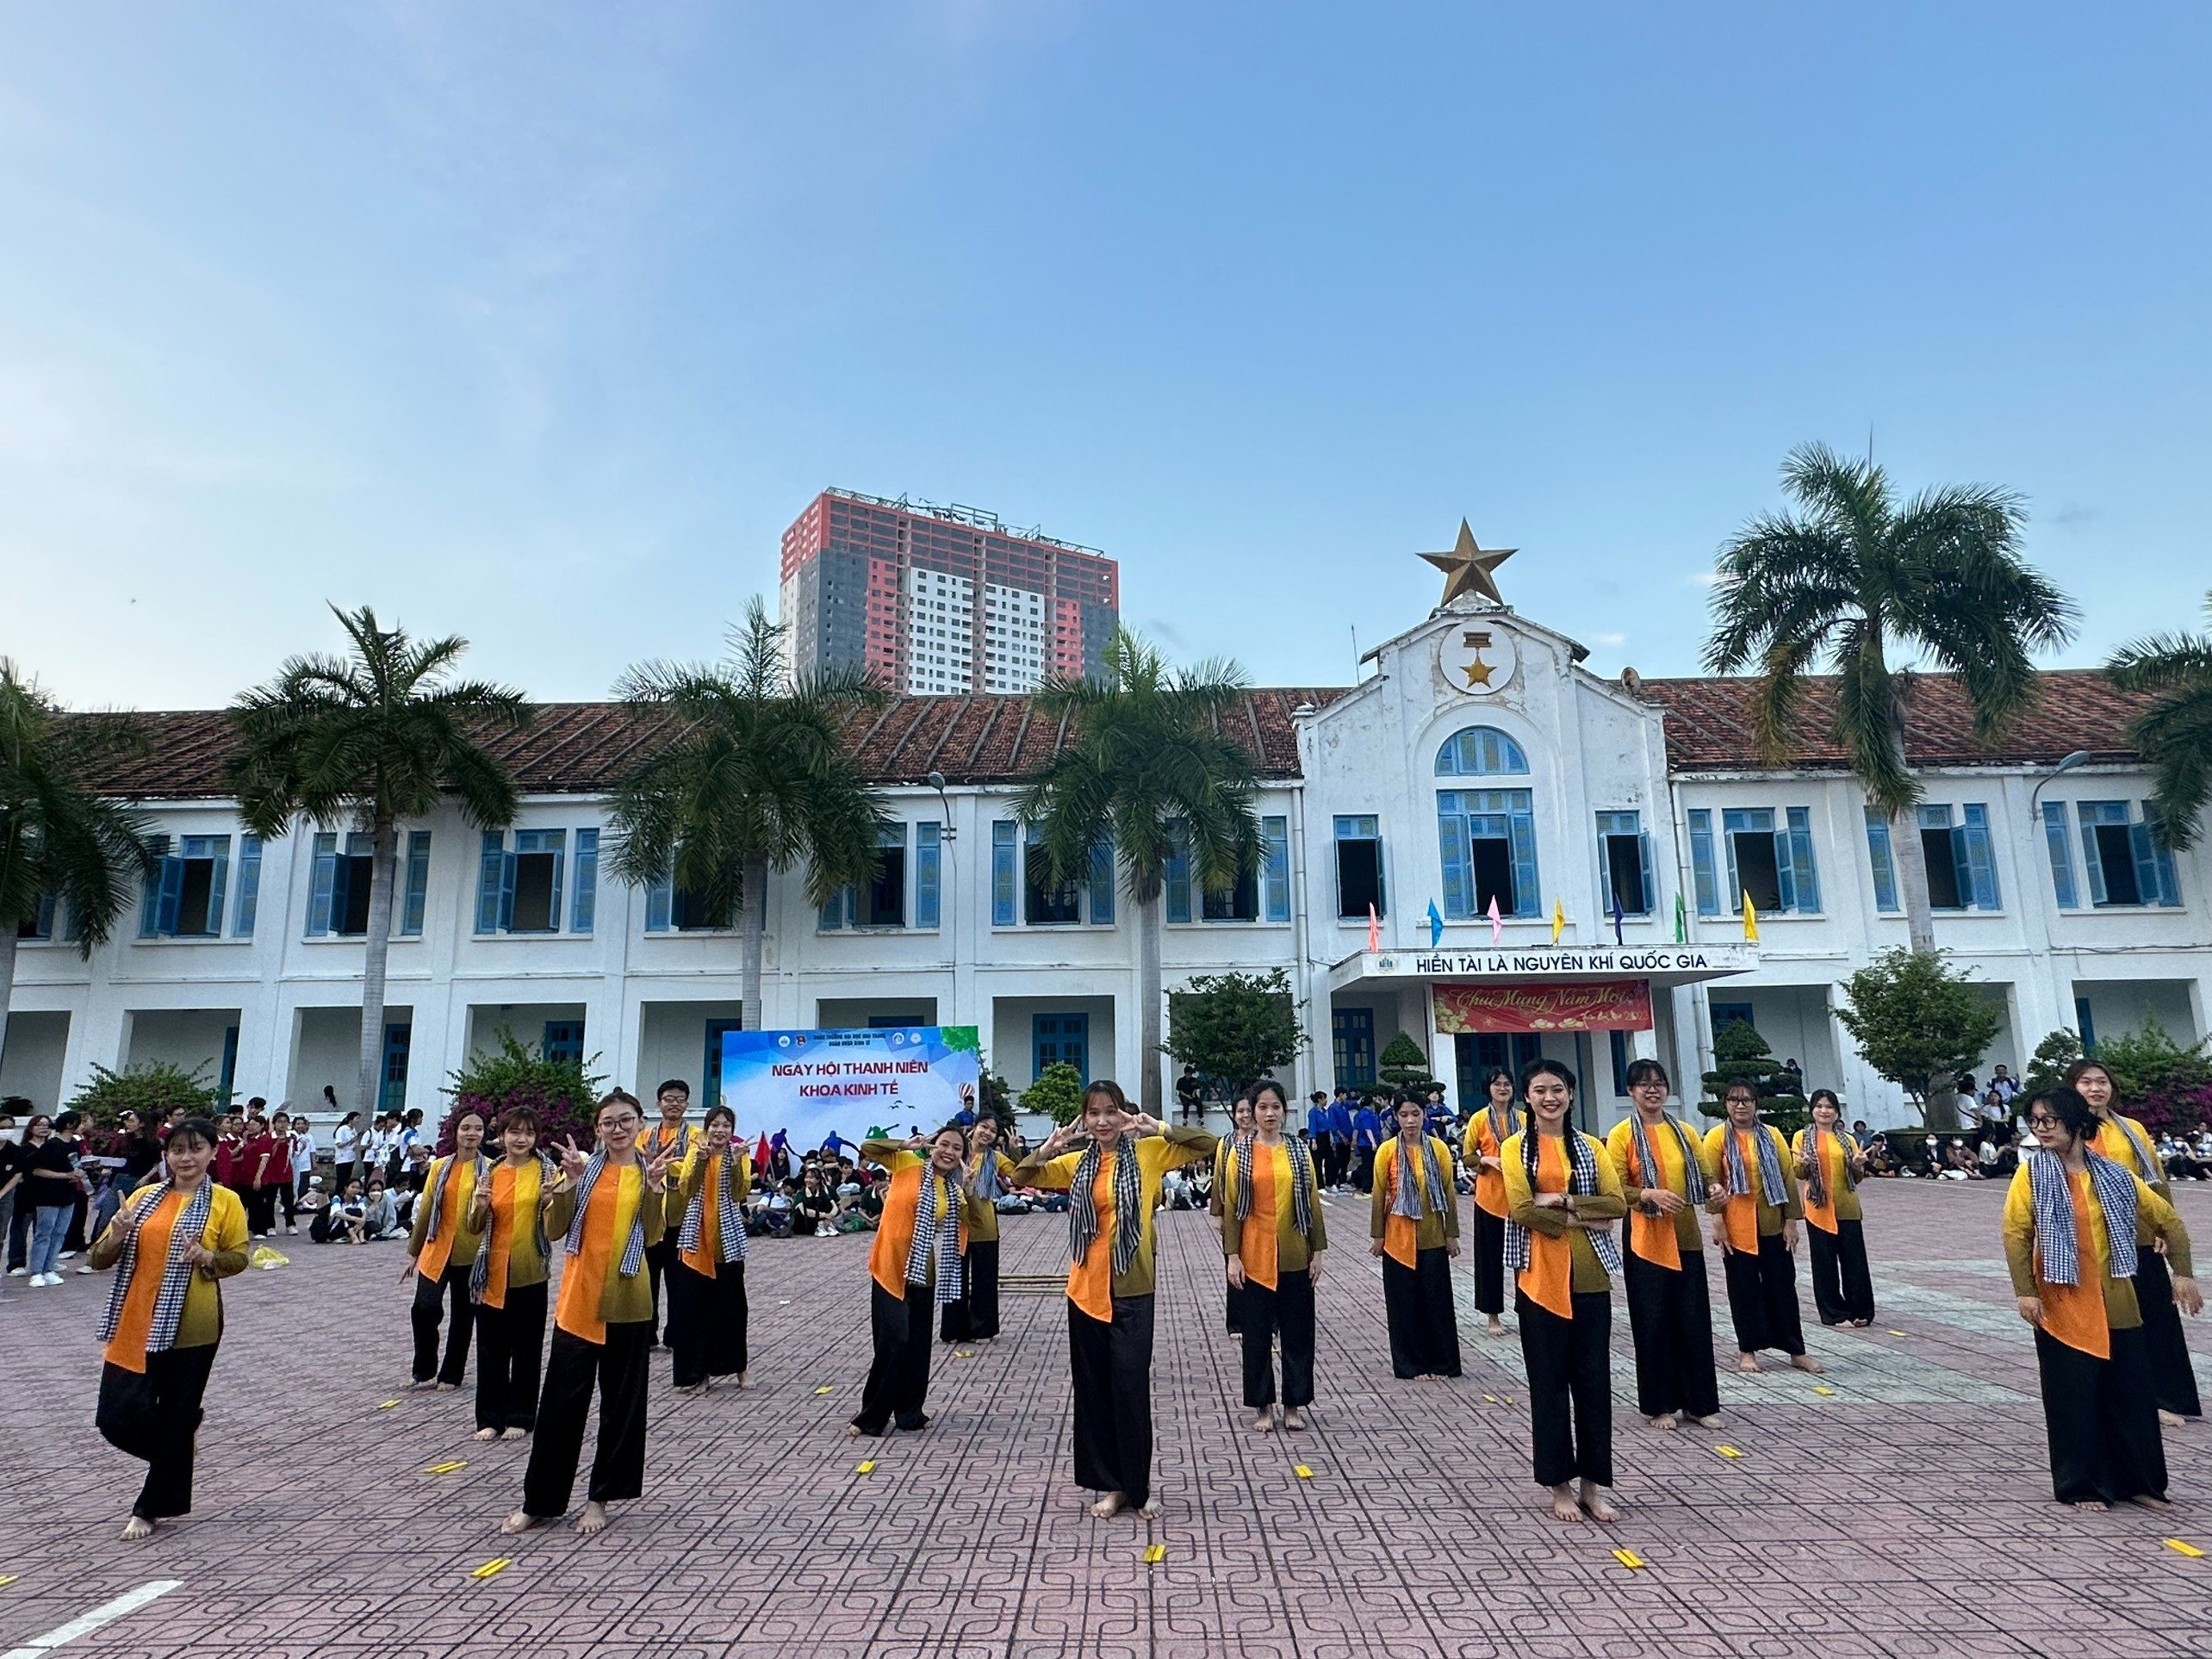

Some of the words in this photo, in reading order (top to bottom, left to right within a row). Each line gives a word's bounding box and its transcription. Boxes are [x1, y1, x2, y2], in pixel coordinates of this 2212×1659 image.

[1417, 952, 1453, 972] HIỀN
[1458, 954, 1482, 972] TÀI
[1488, 954, 1508, 972] LÀ
[1513, 953, 1583, 971] NGUYÊN
[1589, 952, 1613, 969] KHÍ
[1619, 950, 1670, 969] QUỐC
[1676, 954, 1708, 968] GIA
[772, 1061, 814, 1077] NGÀY
[817, 1060, 841, 1077] HỘI
[843, 1061, 893, 1075] THANH
[896, 1059, 929, 1074] NIÊN
[799, 1084, 842, 1097] KHOA
[844, 1083, 878, 1097] KINH
[880, 1078, 898, 1095] TẾ
